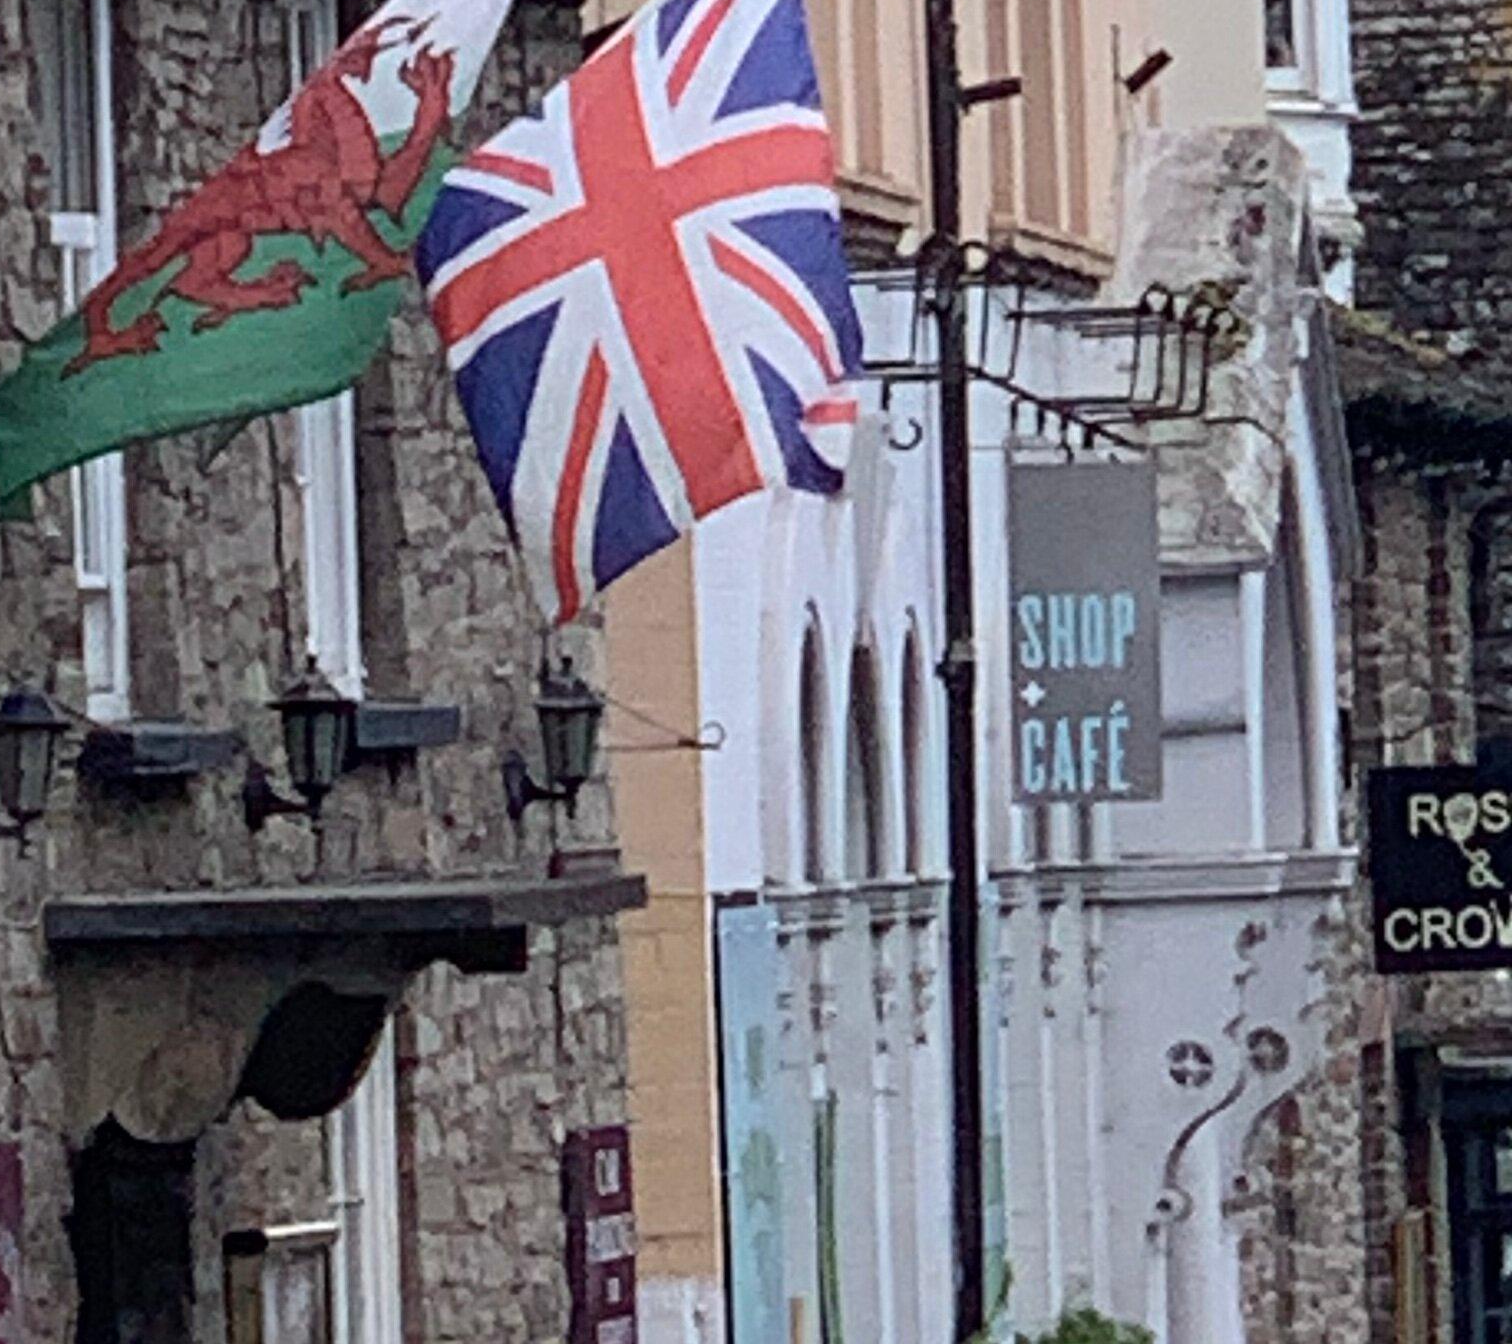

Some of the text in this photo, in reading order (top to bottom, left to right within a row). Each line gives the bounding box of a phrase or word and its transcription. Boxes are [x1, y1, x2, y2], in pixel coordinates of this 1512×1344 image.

[1018, 594, 1136, 670] SHOP
[1020, 700, 1133, 793] CAFÉ
[1466, 848, 1505, 888] &
